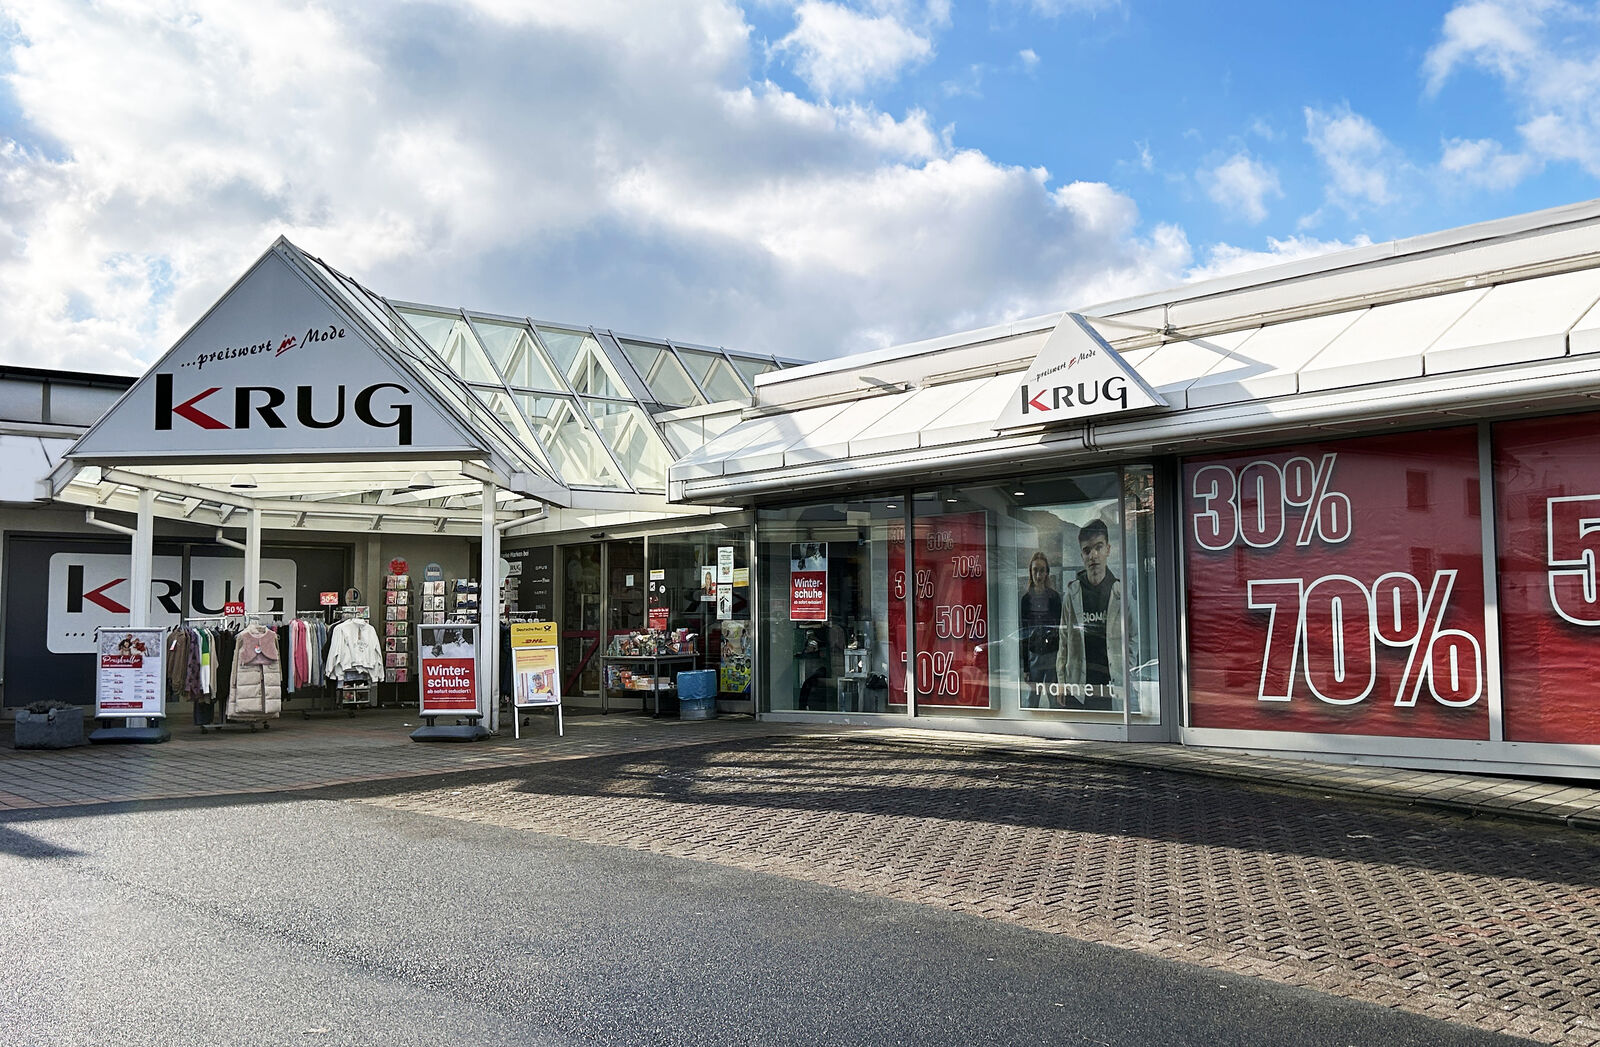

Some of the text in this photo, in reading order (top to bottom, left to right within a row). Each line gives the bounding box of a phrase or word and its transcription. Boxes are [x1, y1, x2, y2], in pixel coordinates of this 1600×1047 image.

[275, 334, 297, 358] in
[300, 325, 346, 349] Mode
[1077, 349, 1096, 365] Mode
[1021, 376, 1128, 414] KRUG
[155, 373, 412, 446] KRUG
[1193, 453, 1352, 550] 30%
[952, 556, 982, 578] 70%
[794, 577, 823, 588] Winter-
[794, 588, 823, 599] schuhe
[895, 570, 935, 599] 3%
[936, 604, 987, 639] 50%
[1247, 569, 1482, 707] 70%
[426, 664, 470, 676] Winter-
[427, 677, 470, 688] schuhe
[1035, 682, 1094, 697] name
